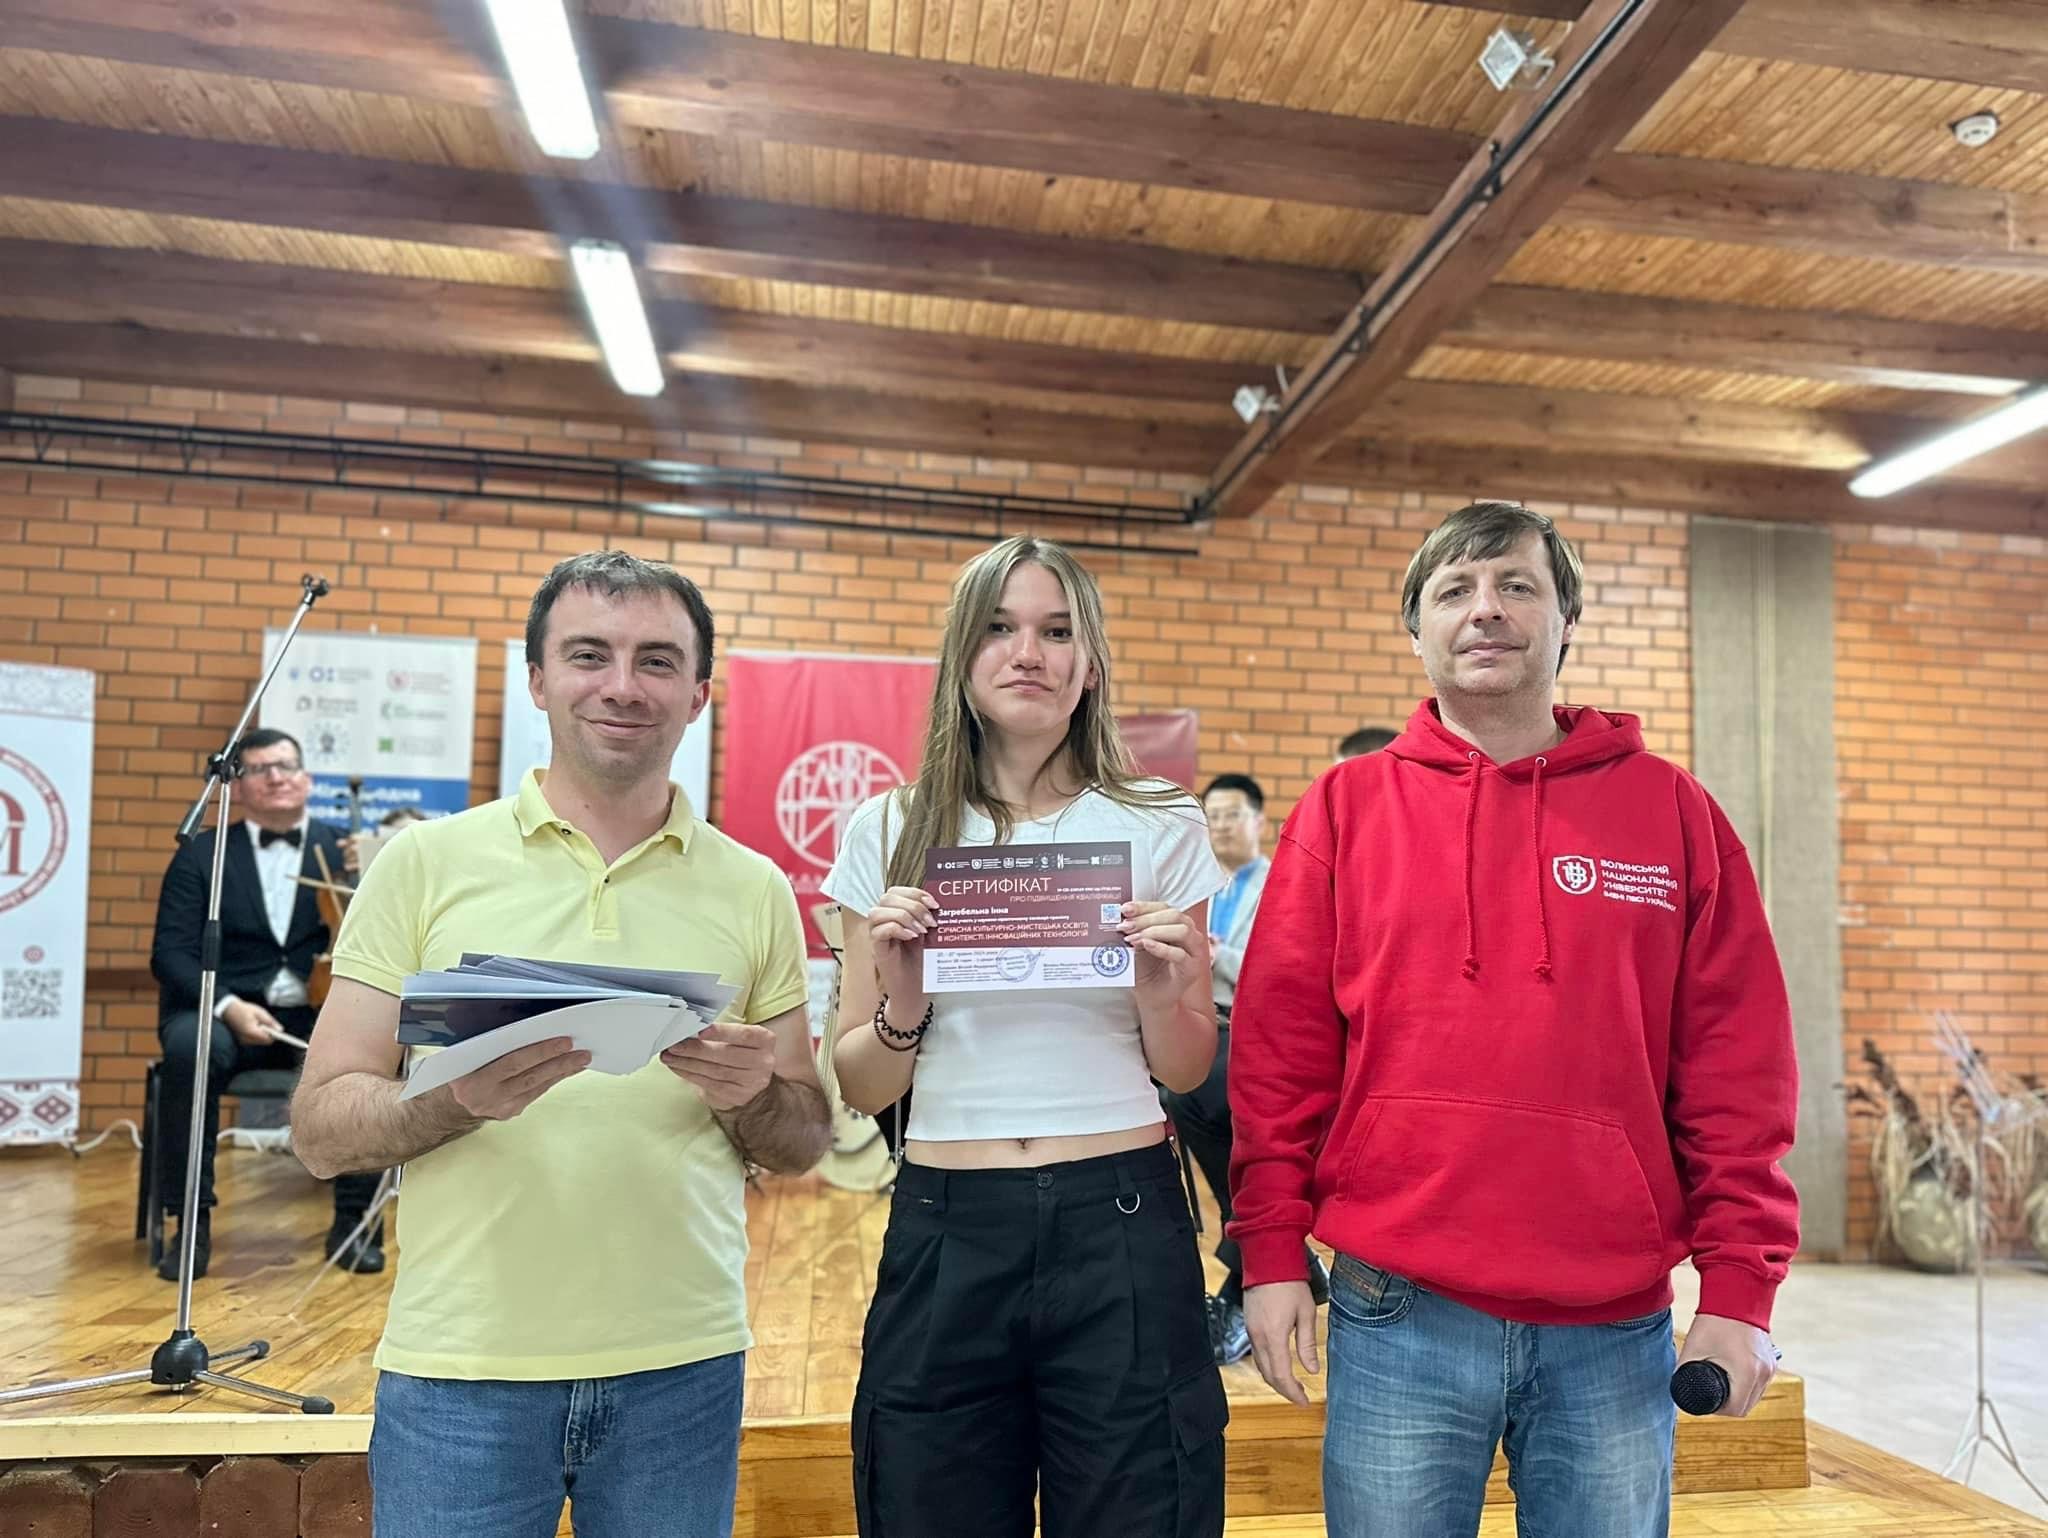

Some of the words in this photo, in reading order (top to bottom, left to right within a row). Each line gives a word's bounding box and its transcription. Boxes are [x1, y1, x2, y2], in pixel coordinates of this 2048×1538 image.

[1600, 859, 1669, 875] ВОЛИНСЬКИЙ
[938, 877, 1052, 896] СЕРТИФІКАТ
[1601, 869, 1678, 890] НАЦІОНАЛЬНИЙ
[1602, 880, 1668, 897] УНІВЕРСИТЕТ
[938, 907, 990, 917] Загребельна
[937, 925, 972, 934] СУЧАСНА
[986, 931, 1042, 940] ІННОВАЦІЙНИХ
[1043, 929, 1089, 938] ТЕХНОЛОГІЙ
